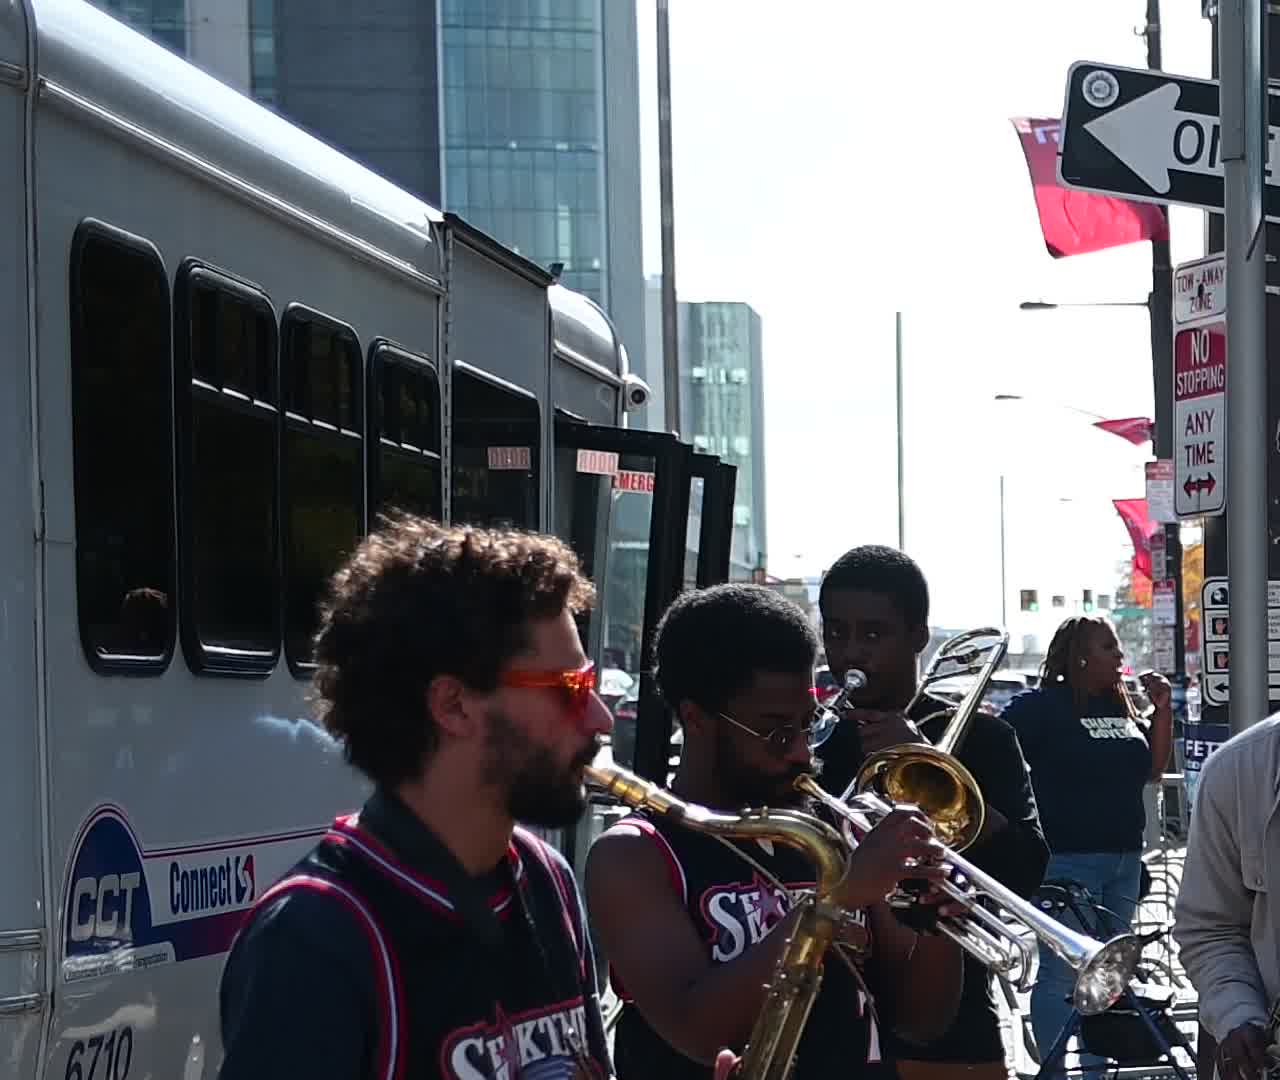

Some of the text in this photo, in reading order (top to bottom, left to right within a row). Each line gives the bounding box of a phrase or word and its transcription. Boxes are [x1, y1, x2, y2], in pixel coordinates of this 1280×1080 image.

[1189, 292, 1213, 314] ZONE
[1190, 329, 1210, 366] NO
[1176, 363, 1225, 397] STOPPING
[1184, 408, 1215, 437] ANY
[1184, 440, 1216, 468] TIME
[71, 856, 232, 942] CCT Connect
